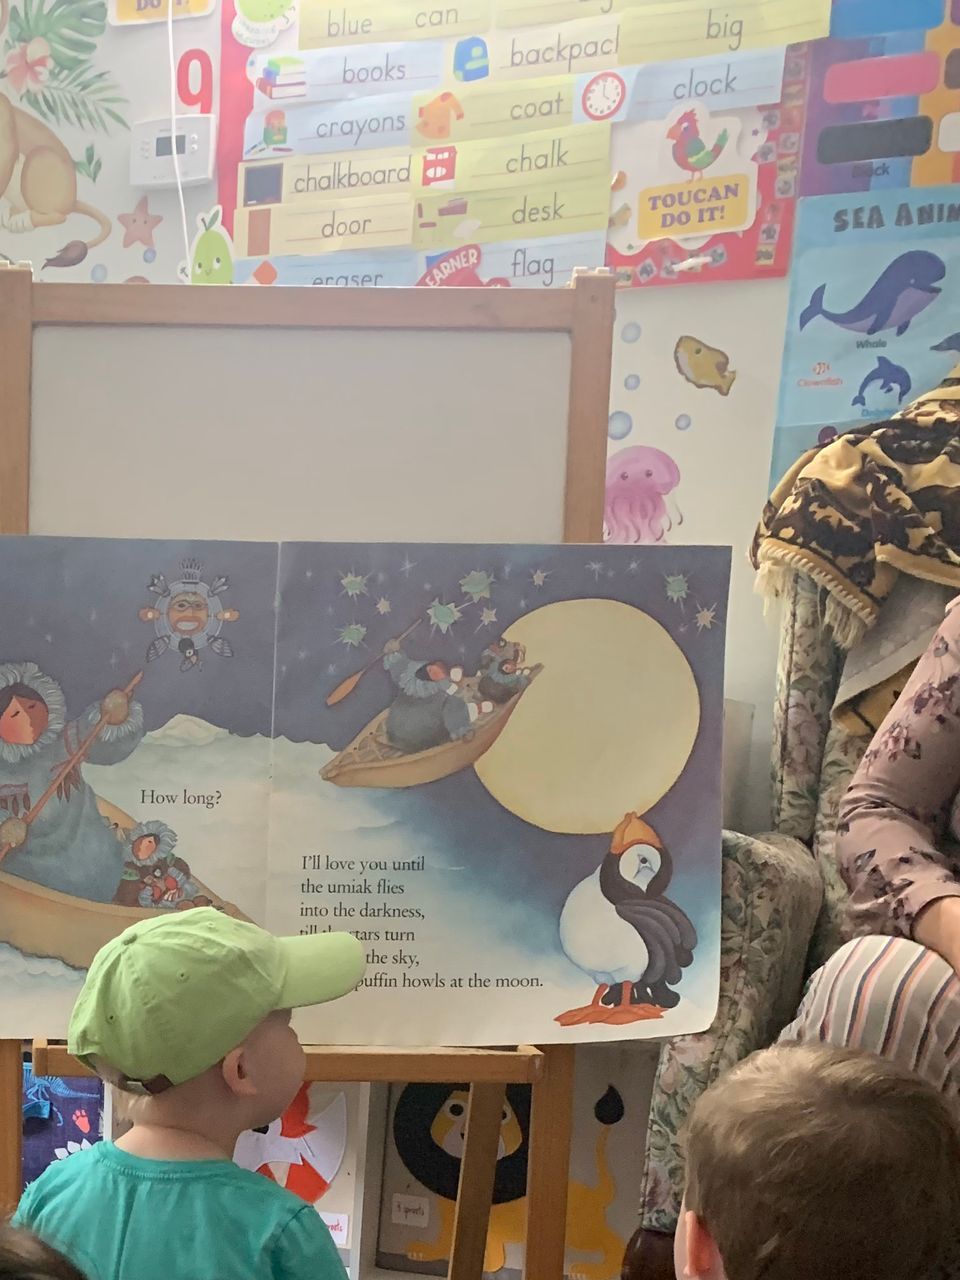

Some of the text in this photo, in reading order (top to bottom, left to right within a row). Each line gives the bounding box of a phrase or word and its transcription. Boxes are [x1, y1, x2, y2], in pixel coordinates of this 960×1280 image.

[327, 10, 373, 38] blue
[414, 8, 458, 28] can
[706, 9, 744, 50] big
[342, 53, 406, 84] books
[673, 64, 737, 100] clock
[510, 94, 563, 121] coat
[316, 112, 406, 145] crayons
[506, 138, 569, 174] chalk
[294, 155, 412, 193] chalkboard
[512, 191, 566, 224] desk
[648, 183, 740, 211] TOUCAN
[322, 210, 372, 238] door
[661, 205, 726, 229] DO IT!
[833, 205, 885, 232] SEA
[511, 248, 555, 287] flag
[856, 338, 888, 350] Whale
[140, 789, 222, 809] How long?
[325, 855, 356, 871] love
[360, 860, 388, 875] you
[392, 855, 426, 871] until
[301, 878, 405, 894] the umiak flies
[300, 901, 425, 920] into the darkness,
[385, 929, 415, 942] turn
[366, 949, 420, 968] the sky,
[403, 973, 446, 988] howls
[450, 976, 463, 988] at
[469, 973, 491, 988] the
[495, 976, 544, 988] moon.
